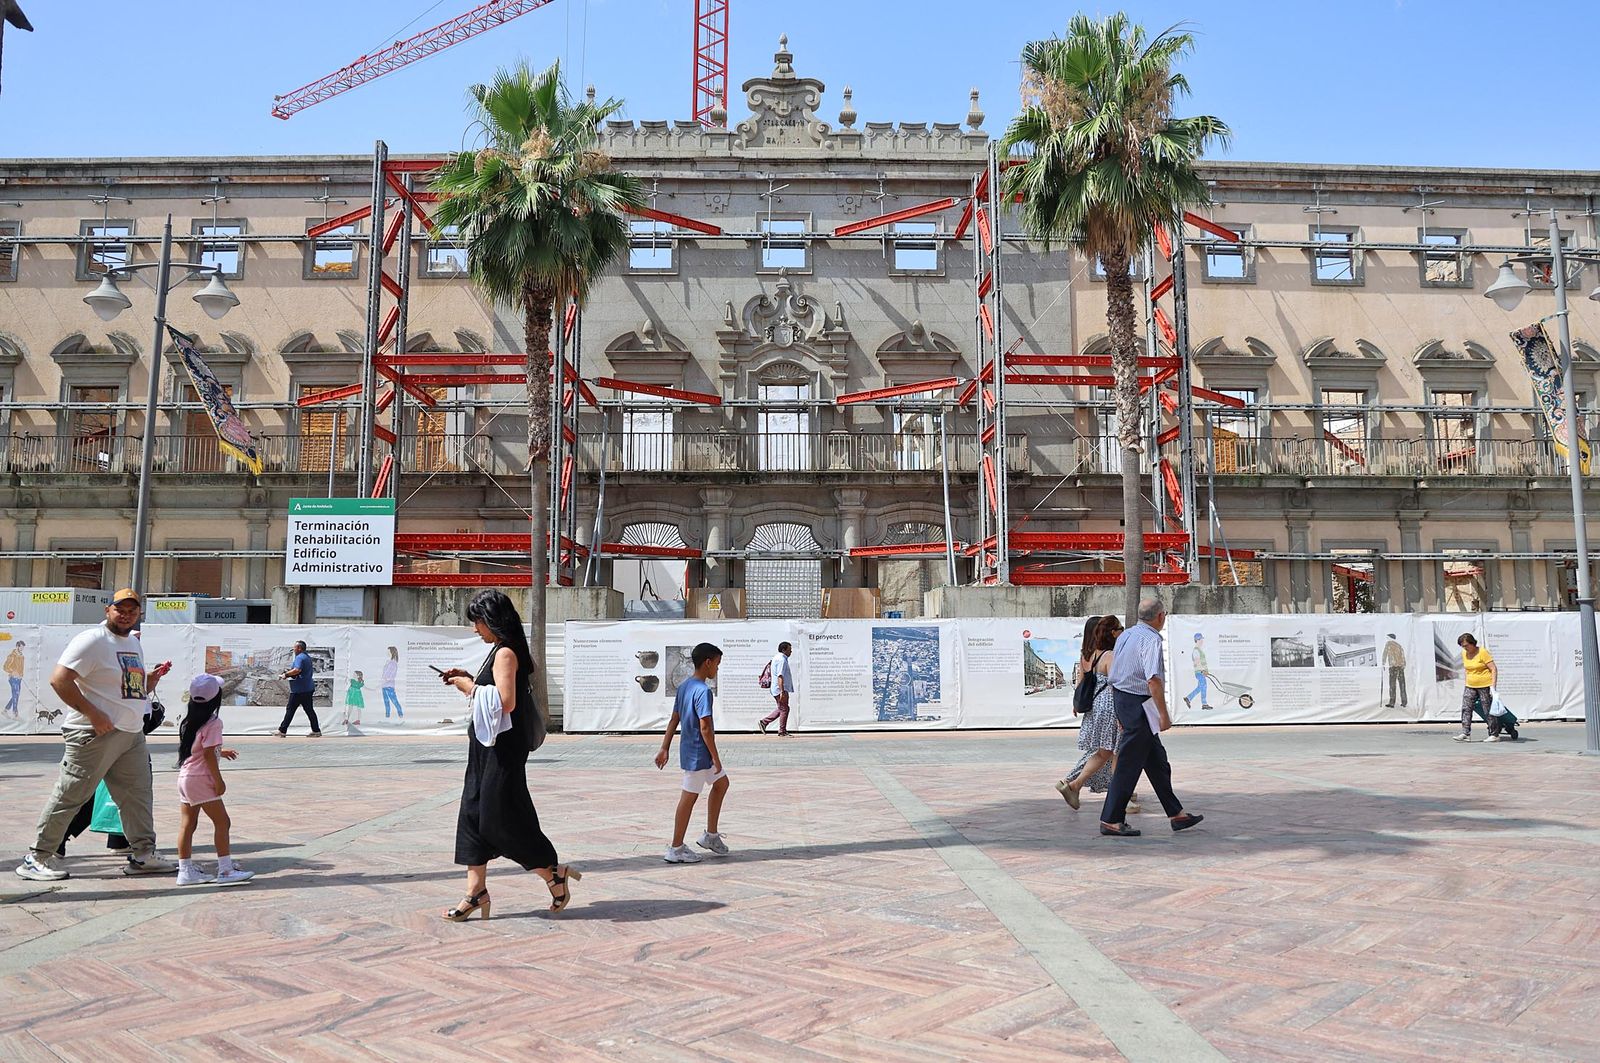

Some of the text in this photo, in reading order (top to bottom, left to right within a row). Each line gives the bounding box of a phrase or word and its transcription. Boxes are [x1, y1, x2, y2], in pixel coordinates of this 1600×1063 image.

[294, 520, 369, 531] Terminación
[294, 534, 380, 545] Rehabilitación
[293, 548, 337, 558] Edificio
[292, 562, 383, 573] Administrativo
[32, 592, 69, 600] PICOTE
[75, 594, 81, 602] EL
[82, 595, 96, 604] PICOTE
[204, 611, 236, 619] EL PICOTE
